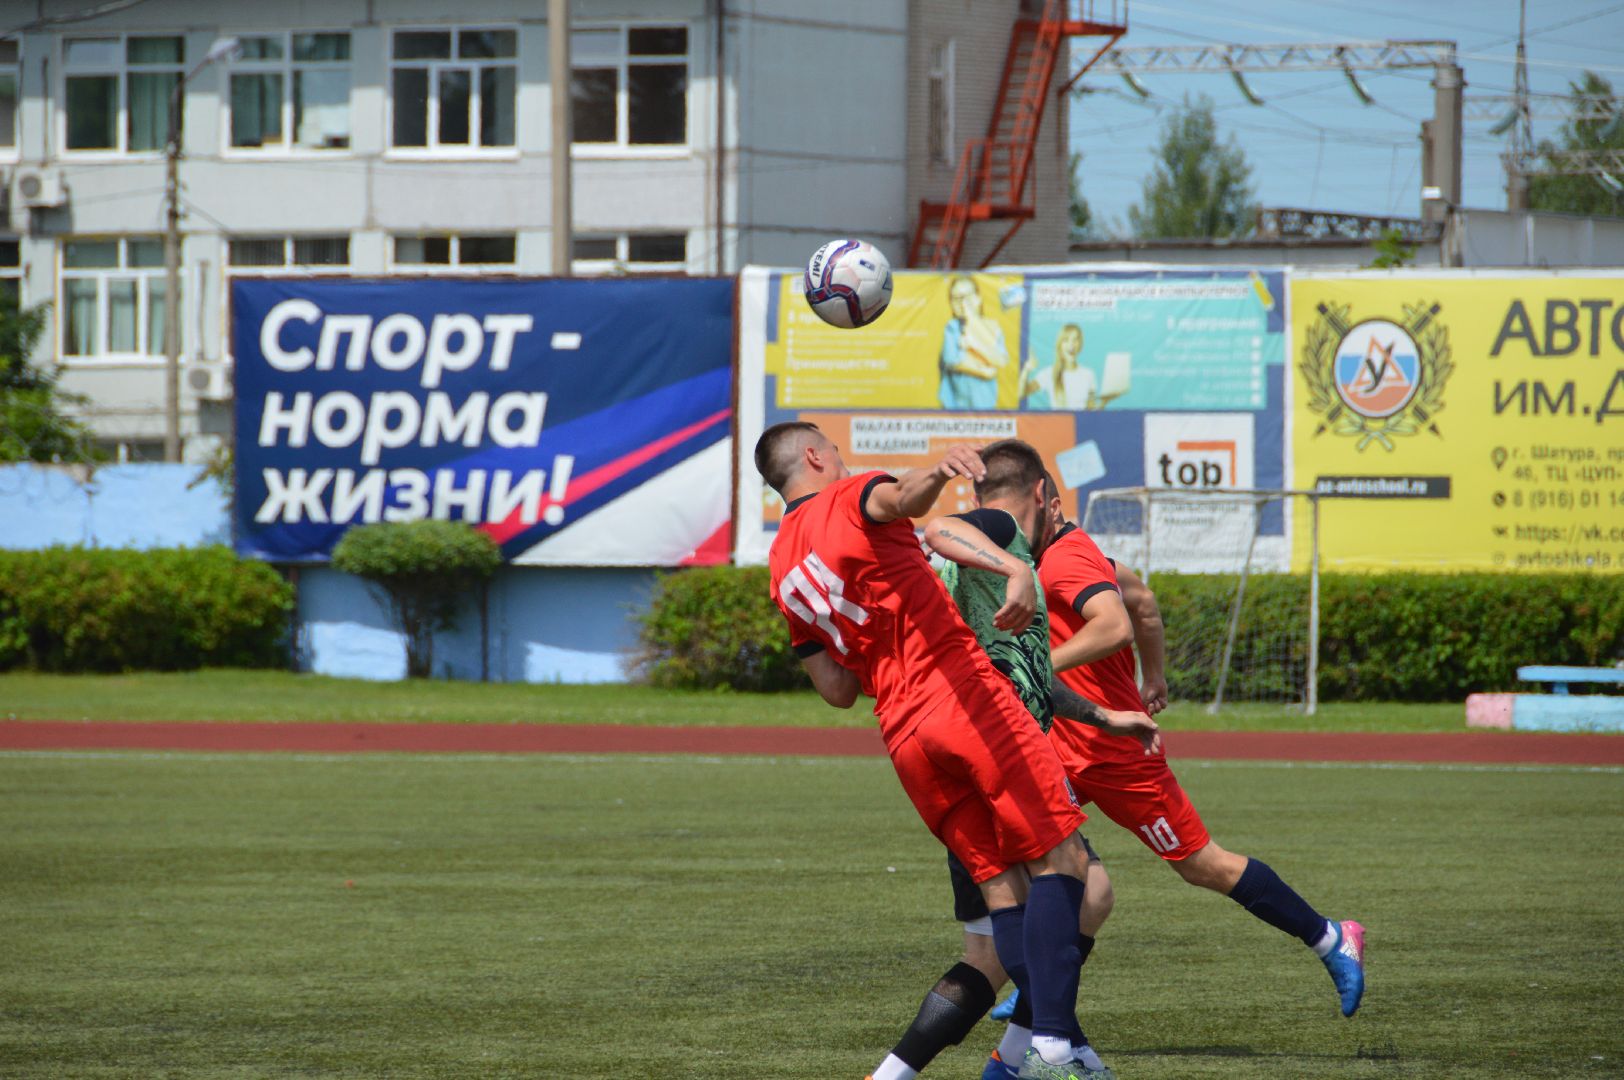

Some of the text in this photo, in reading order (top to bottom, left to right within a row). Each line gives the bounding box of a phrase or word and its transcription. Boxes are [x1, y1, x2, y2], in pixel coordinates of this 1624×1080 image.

[259, 298, 533, 388] Спорт
[1488, 298, 1624, 357] АВТ
[258, 391, 548, 465] норма
[254, 455, 575, 526] жизни!
[1139, 816, 1181, 853] 10
